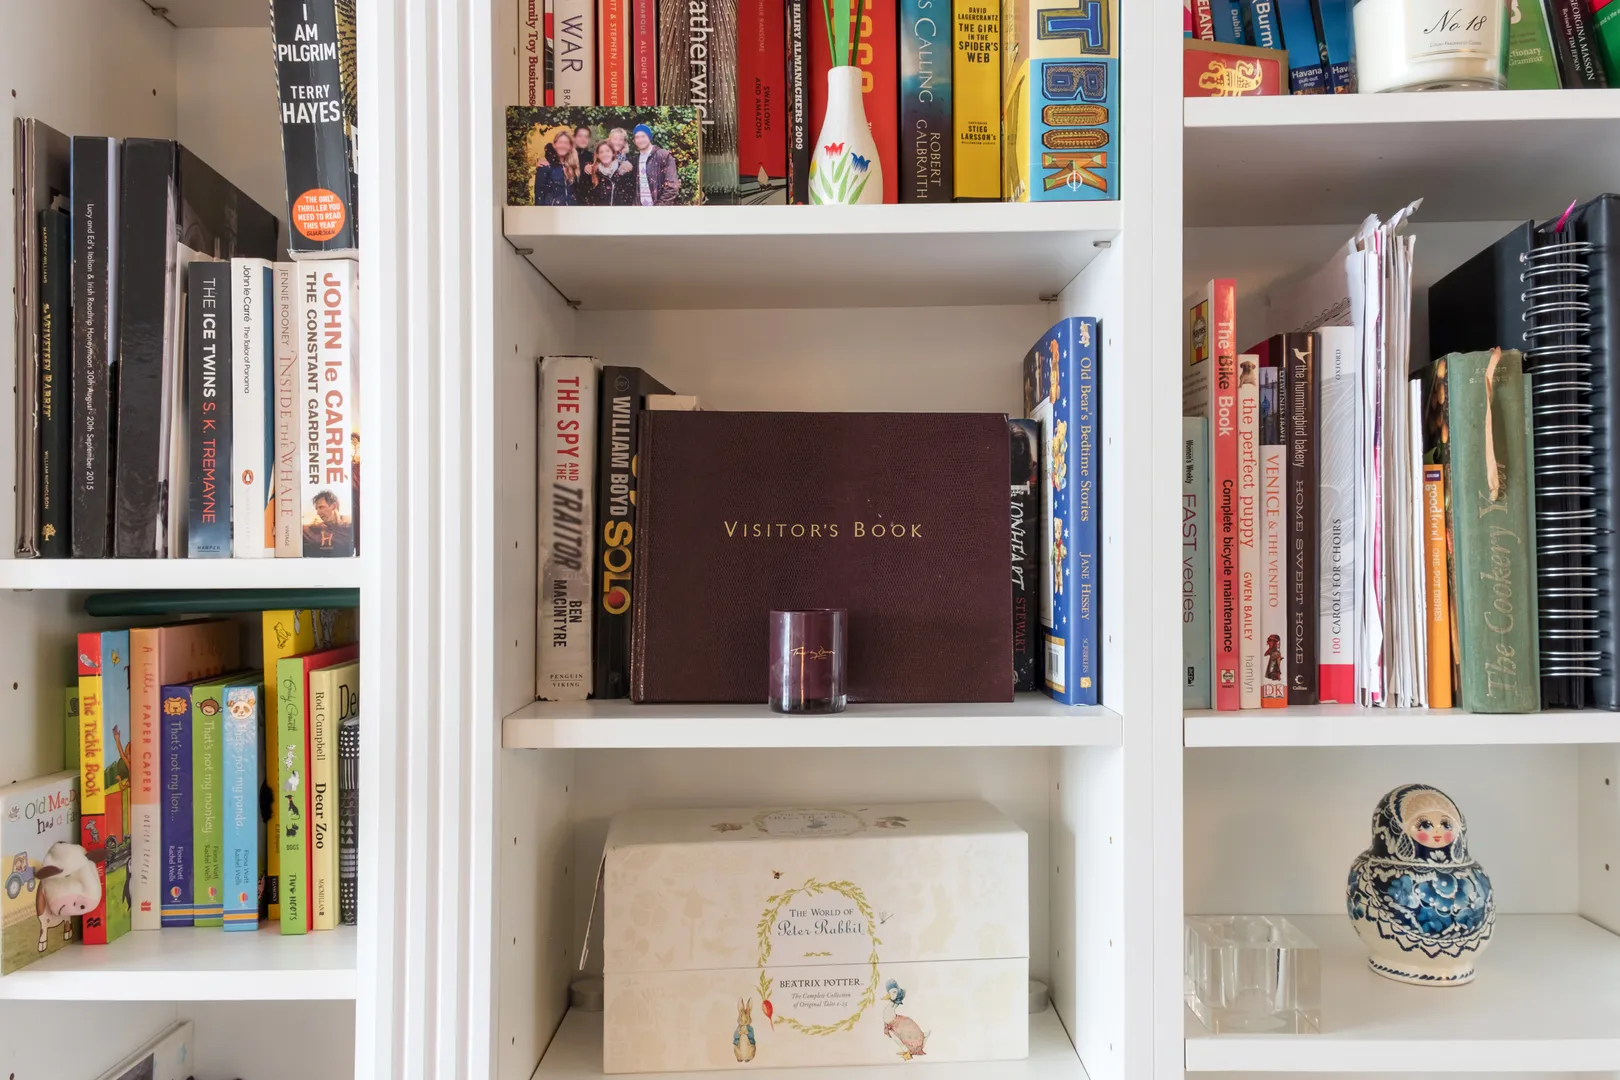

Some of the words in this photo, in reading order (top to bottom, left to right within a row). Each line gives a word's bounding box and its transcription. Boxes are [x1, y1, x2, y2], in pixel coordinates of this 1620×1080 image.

[302, 3, 309, 21] I
[793, 3, 801, 39] HAIRY
[958, 13, 999, 21] LAGERCRANTZ
[959, 23, 975, 33] THE
[977, 23, 998, 33] GIRL
[1231, 9, 1242, 38] Dublin
[1465, 15, 1488, 32] 18
[294, 23, 318, 41] AM
[561, 15, 583, 72] WAR
[959, 41, 999, 51] SPIDER'S
[277, 42, 337, 62] PILGRIM
[967, 52, 990, 63] WEB
[1580, 43, 1596, 81] MASSON
[794, 40, 802, 124] ALMANACKERS
[1292, 68, 1323, 78] Havana
[290, 84, 330, 99] TERRY
[282, 100, 341, 124] HAYES
[1041, 62, 1109, 192] BOOK
[795, 125, 803, 150] 2009
[916, 120, 927, 198] GALBRAITH
[930, 133, 941, 186] ROBERT
[86, 203, 95, 219] Lucy
[87, 235, 95, 250] Ed's
[87, 281, 95, 296] Irish
[243, 265, 252, 287] John
[243, 287, 252, 296] le
[279, 269, 290, 301] JENNIE
[306, 272, 318, 303] THE
[202, 278, 216, 309] THE
[243, 296, 253, 322] Carré
[85, 297, 94, 326] Roadtrip
[203, 313, 216, 339] ICE
[280, 304, 290, 346] ROONEY
[323, 272, 342, 350] JOHN
[85, 327, 94, 368] Honeymoon
[243, 326, 251, 339] The
[243, 339, 251, 356] Tailor
[1218, 320, 1233, 350] The
[243, 356, 251, 364] of
[307, 309, 318, 393] CONSTANT
[203, 344, 216, 398] TWINS
[243, 364, 251, 394] Panama
[279, 350, 298, 418] INSIDE
[324, 361, 342, 381] le
[1080, 357, 1092, 380] Old
[1218, 355, 1233, 390] Bike
[1294, 365, 1307, 378] the
[85, 387, 94, 411] August
[203, 402, 216, 415] S.
[556, 376, 580, 414] THE
[1080, 384, 1093, 421] Bear's
[1242, 397, 1257, 424] the
[1292, 381, 1307, 436] hummingbird
[203, 419, 216, 434] K.
[611, 396, 631, 468] WILLIAM
[1218, 395, 1234, 437] Book
[280, 420, 289, 448] THE
[308, 398, 320, 485] GARDENER
[324, 390, 348, 485] CARRÉ
[556, 420, 580, 458] SPY
[85, 433, 94, 469] September
[1080, 425, 1092, 477] Bedtime
[1185, 439, 1194, 463] Women's
[1239, 430, 1257, 490] perfect
[1292, 439, 1307, 468] bakery
[203, 438, 216, 523] TREMAYNE
[280, 441, 297, 518] WHALE
[556, 463, 567, 480] THE
[568, 462, 579, 481] AND
[1184, 464, 1194, 485] Weekly
[1266, 454, 1280, 517] VENICE
[610, 473, 629, 516] BOYD
[1080, 480, 1092, 522] Stories
[1220, 479, 1234, 533] Complete
[1295, 479, 1304, 532] HOME
[552, 483, 584, 572] TRAITOR
[1182, 494, 1197, 552] FAST
[1240, 495, 1255, 548] puppy
[1269, 521, 1278, 530] &
[1221, 536, 1234, 576] bicycle
[1269, 532, 1278, 557] THE
[1332, 518, 1342, 563] CHOIRS
[603, 520, 633, 615] SOLO
[1269, 559, 1278, 608] VENETO
[1295, 538, 1304, 605] SWEET
[1332, 565, 1342, 588] FOR
[1432, 547, 1441, 588] ONE-POT
[1480, 525, 1521, 634] Cookery
[1243, 571, 1252, 601] GWEN
[553, 580, 567, 647] MACINTYRE
[569, 600, 582, 623] BEN
[1223, 579, 1234, 653] maintenance
[1332, 590, 1342, 635] CAROLS
[1433, 589, 1443, 622] DISHES
[1016, 597, 1026, 654] STEWART
[1244, 605, 1252, 641] BAILEY
[1295, 611, 1304, 664] HOME
[1332, 637, 1342, 656] 100
[1243, 655, 1255, 694] hamlyn
[1485, 643, 1518, 699] The
[83, 693, 99, 716] The
[315, 691, 325, 711] Rod
[1264, 686, 1283, 696] DK
[83, 720, 101, 758] Tickle
[143, 704, 151, 744] PAPER
[170, 720, 182, 751] That's
[314, 713, 326, 761] Campbell
[143, 752, 151, 793] CAPER
[170, 753, 181, 771] not
[84, 762, 101, 798] Book
[167, 774, 179, 790] my
[315, 782, 326, 819] Dear
[315, 823, 328, 850] Zoo
[777, 919, 811, 937] Peter
[814, 919, 863, 936] Rabbit
[779, 978, 820, 989] BEATRIX
[823, 978, 861, 988] POTTER
[791, 992, 801, 1000] The
[801, 992, 825, 1001] Complete
[825, 991, 851, 999] Collection
